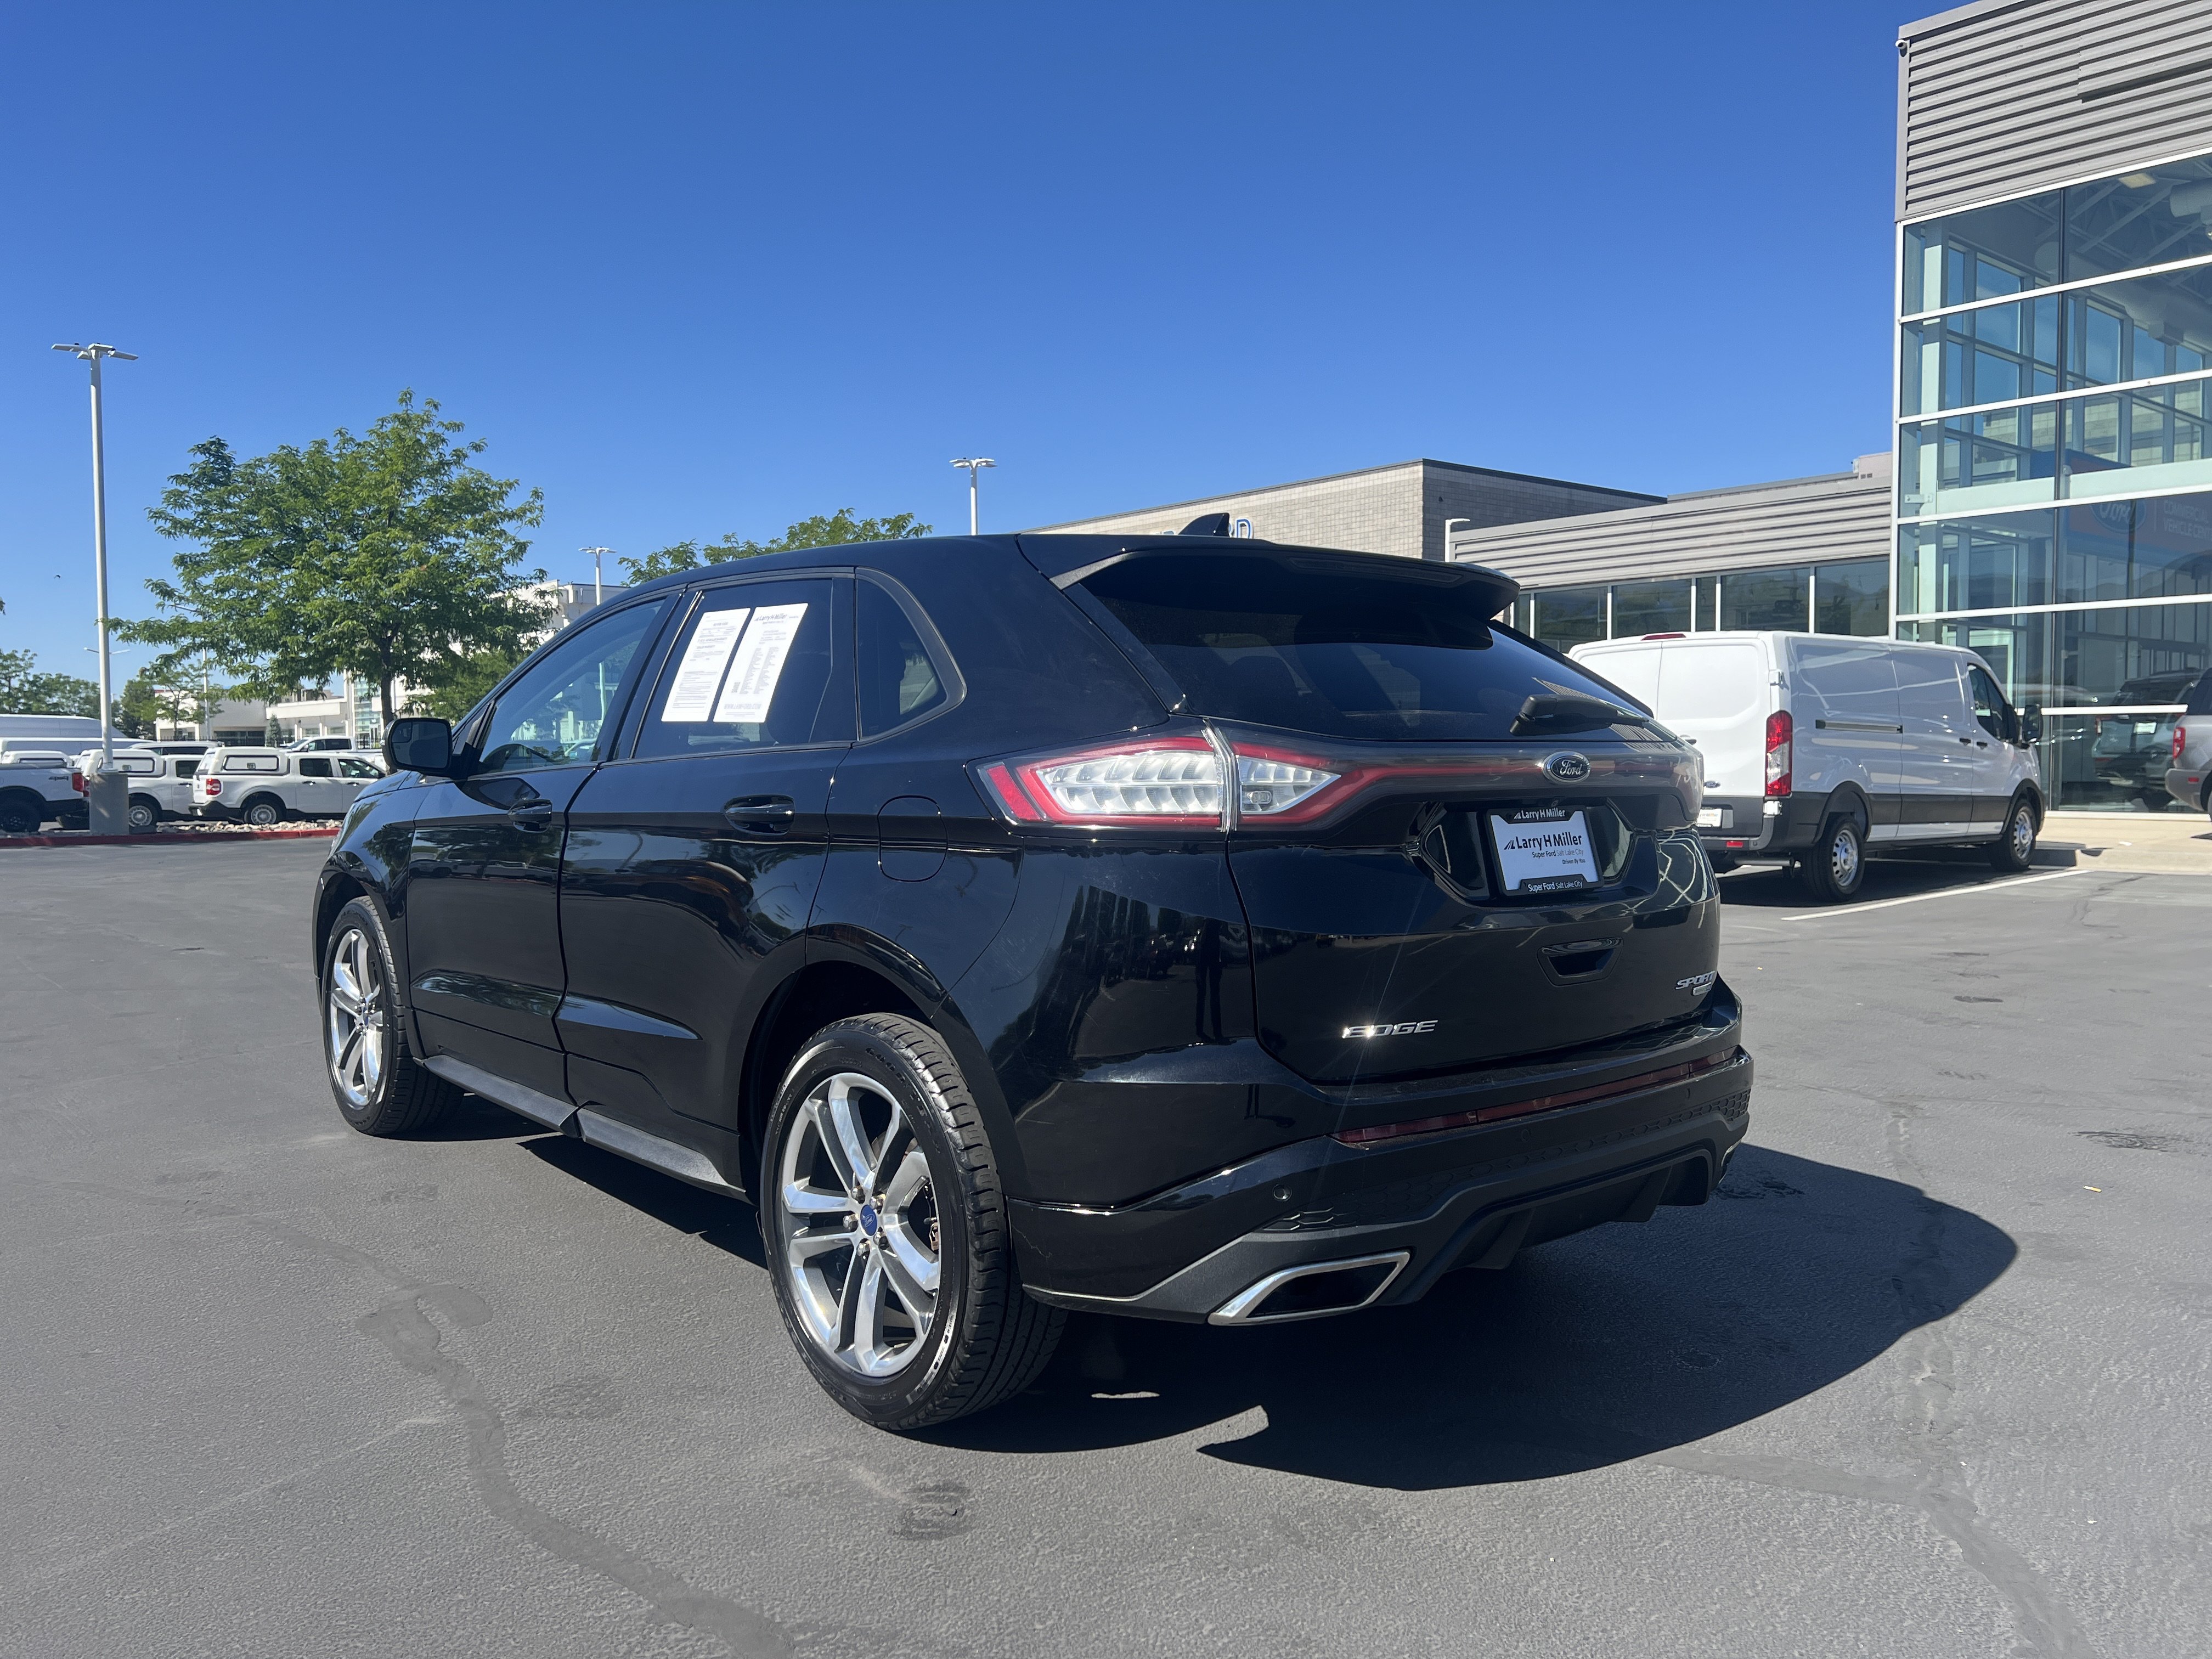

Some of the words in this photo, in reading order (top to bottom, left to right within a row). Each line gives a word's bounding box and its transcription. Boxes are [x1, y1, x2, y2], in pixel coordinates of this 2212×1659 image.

[1560, 759, 1584, 775] Ford
[1521, 810, 1539, 820] Larry
[1539, 809, 1546, 818] H
[1546, 807, 1566, 817] Miller
[1515, 836, 1542, 851] Larry
[1543, 834, 1553, 847] H
[1553, 831, 1582, 847] Miller
[1528, 884, 1543, 893] Super
[1543, 882, 1555, 890] Ford
[1574, 880, 1583, 888] City
[1675, 970, 1716, 990] SPORT
[1342, 1020, 1438, 1039] EDGE
